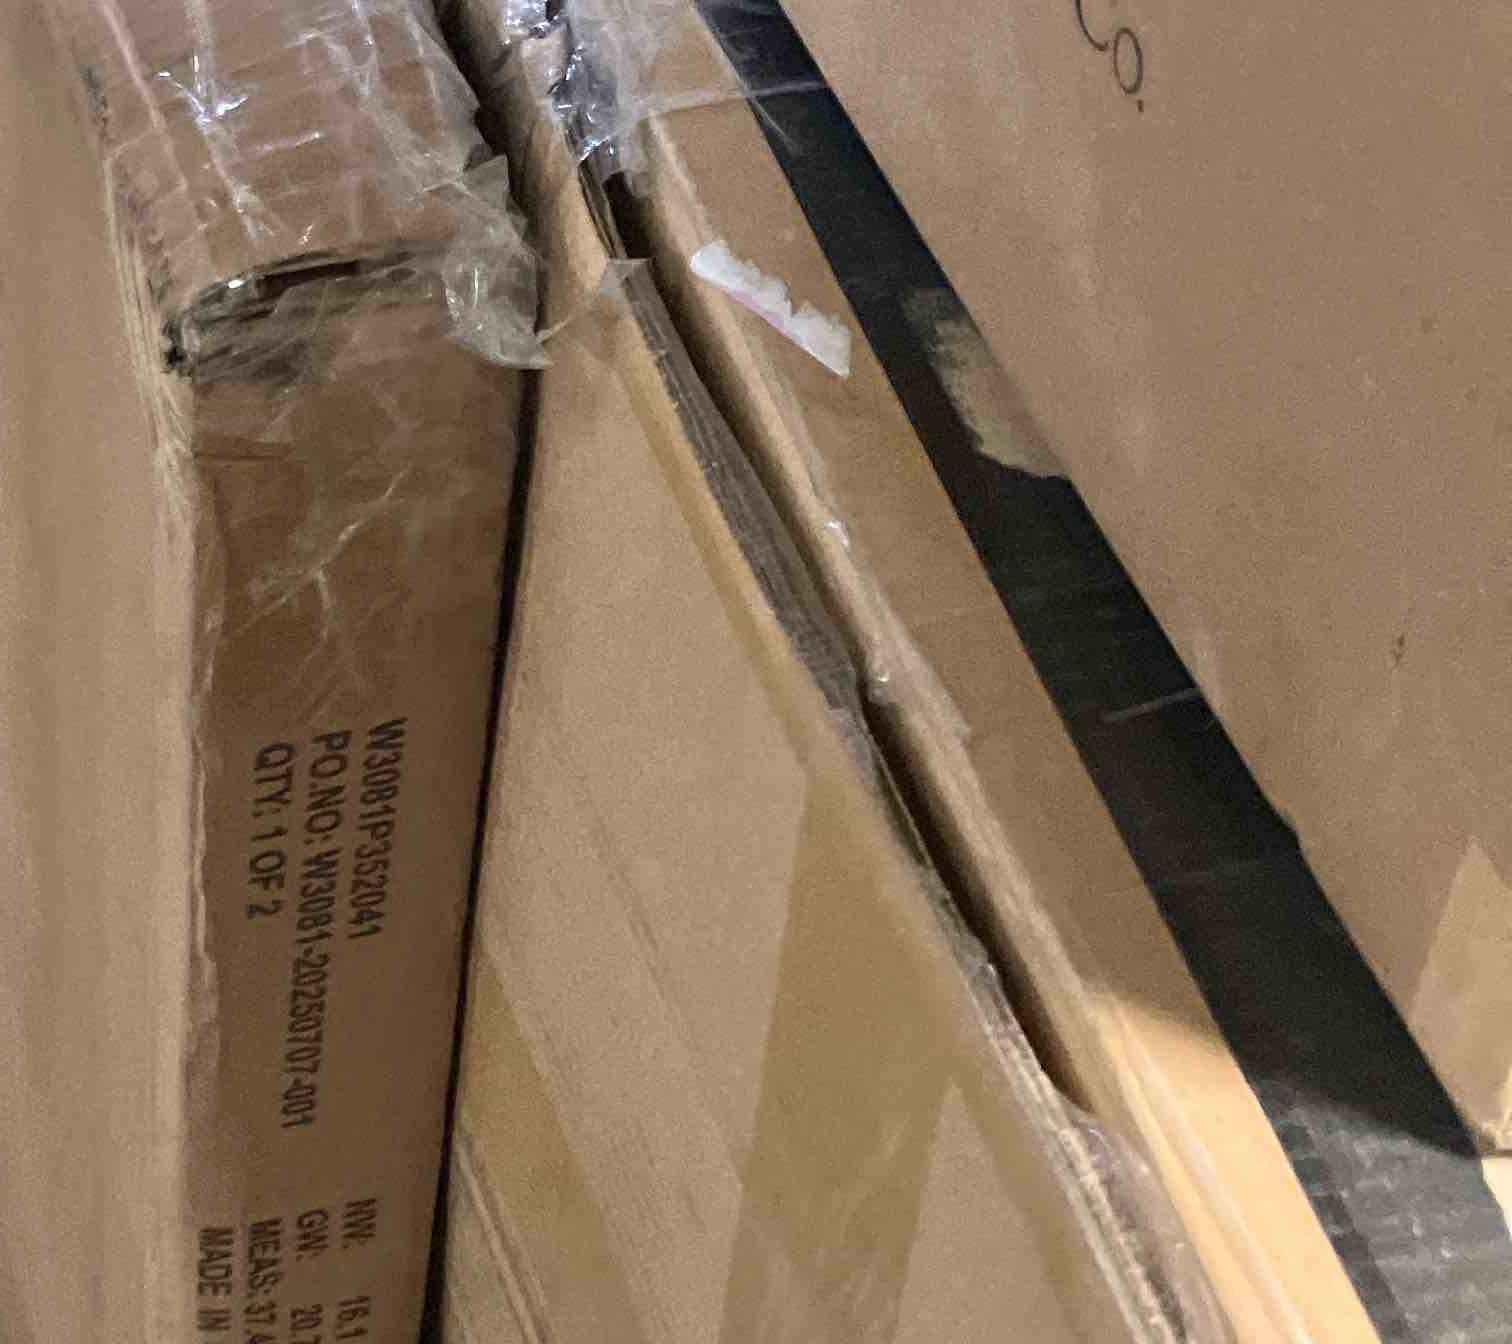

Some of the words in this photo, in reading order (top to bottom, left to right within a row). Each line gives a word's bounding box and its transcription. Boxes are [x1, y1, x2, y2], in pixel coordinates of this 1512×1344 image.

[252, 742, 297, 819] QTY:
[249, 824, 289, 843] 1
[348, 716, 408, 940] W3081P352041
[247, 849, 288, 892] OF
[247, 898, 285, 920] 2
[199, 1227, 234, 1297] MADE
[247, 1217, 283, 1299] MEAS:
[296, 1208, 329, 1262] GW:
[197, 1308, 233, 1331] IN
